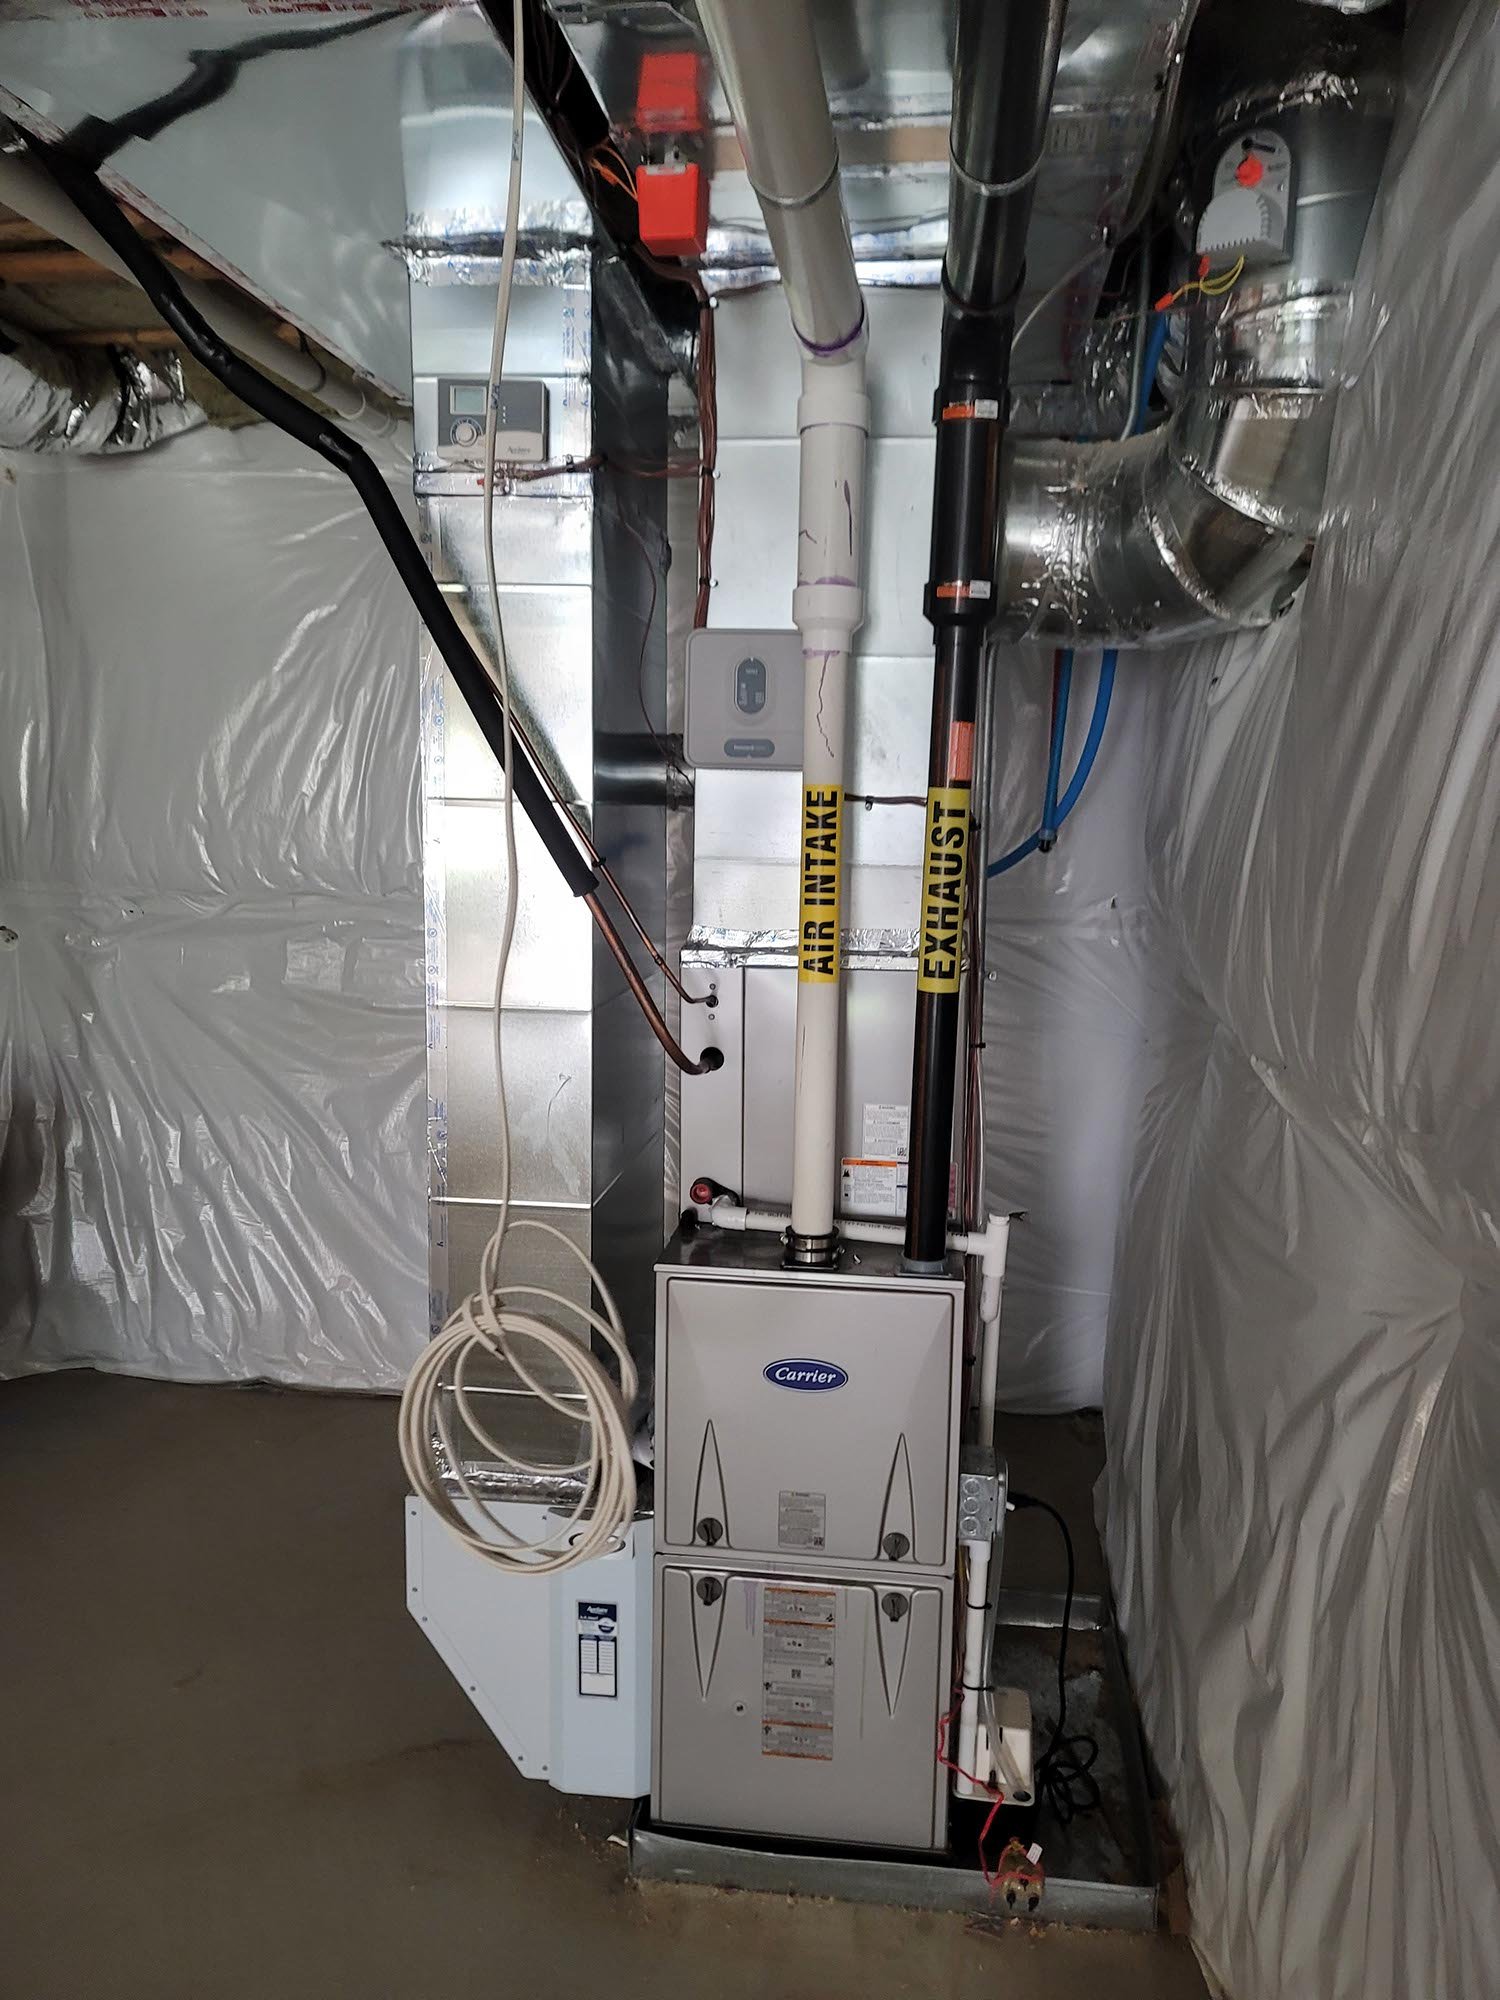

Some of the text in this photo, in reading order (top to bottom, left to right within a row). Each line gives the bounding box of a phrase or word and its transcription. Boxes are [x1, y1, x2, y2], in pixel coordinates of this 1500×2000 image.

[803, 790, 838, 976] AIR INTAKE
[923, 801, 966, 980] EXHAUST
[775, 1367, 836, 1383] Carrier
